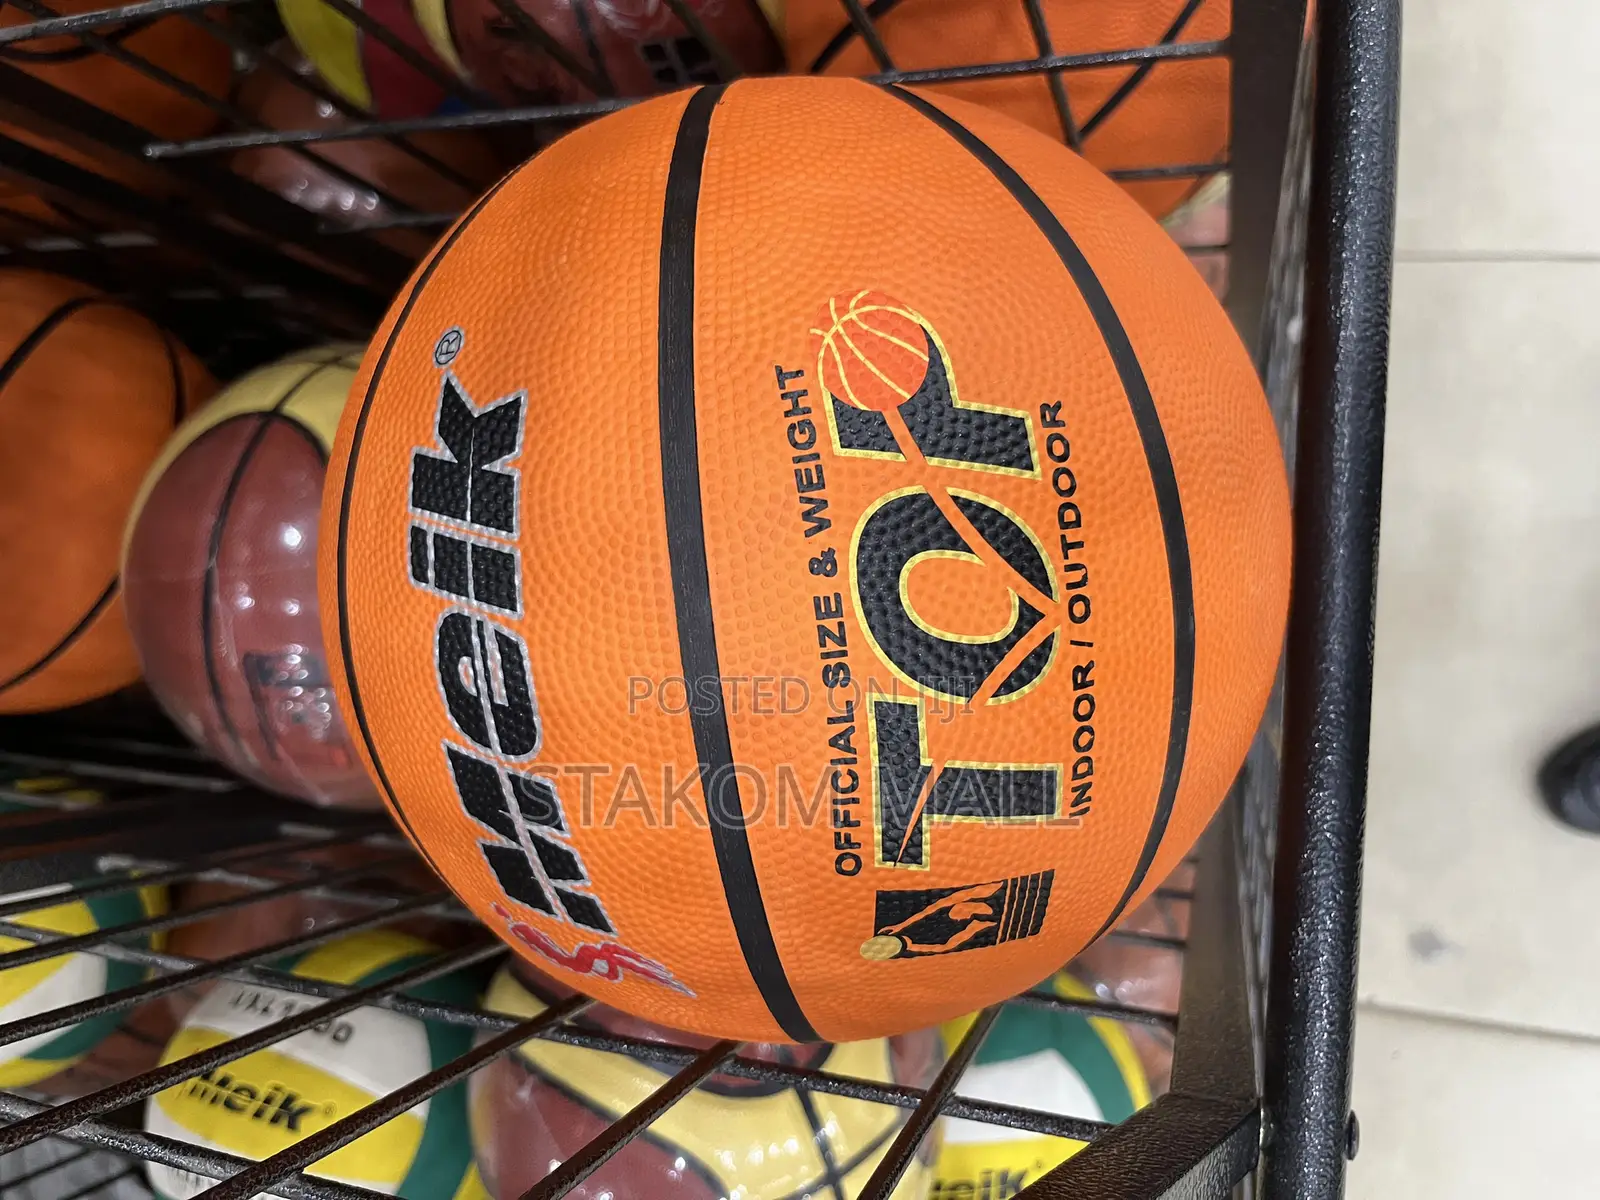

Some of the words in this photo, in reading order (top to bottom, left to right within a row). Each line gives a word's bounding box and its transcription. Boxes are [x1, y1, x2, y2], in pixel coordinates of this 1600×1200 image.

[774, 364, 833, 539] WEIGHT
[1039, 400, 1093, 625] OUTDOOR
[808, 547, 840, 579] &
[809, 288, 1064, 873] TOP
[812, 591, 853, 689] SIZE
[827, 700, 863, 877] OFFICIAL
[1068, 659, 1097, 818] INDOOR
